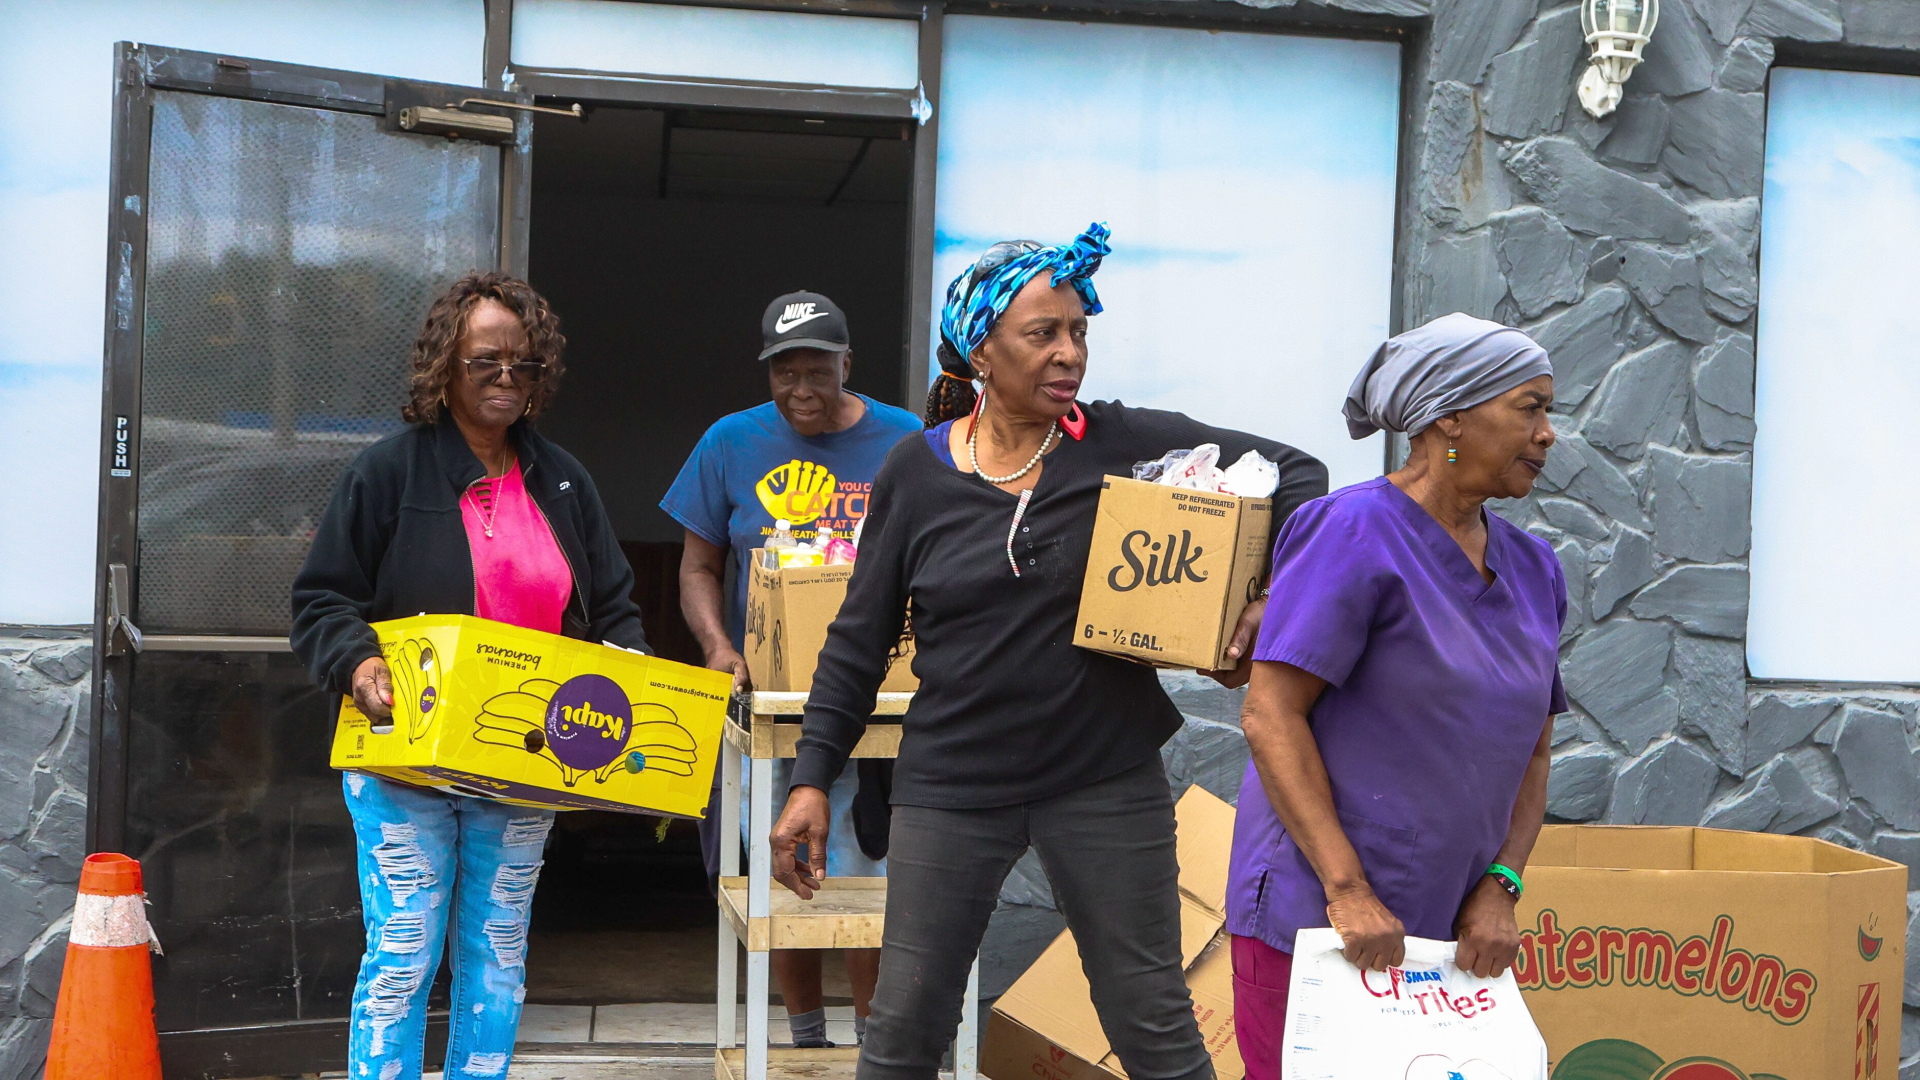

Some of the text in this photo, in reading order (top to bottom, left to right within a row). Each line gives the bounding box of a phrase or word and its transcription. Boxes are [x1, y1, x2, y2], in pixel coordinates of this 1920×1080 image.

[782, 301, 818, 321] NIKE
[115, 417, 128, 467] PUSH
[838, 481, 862, 492] YOU
[1171, 492, 1235, 509] KEEP REFRIGERATED
[1178, 503, 1226, 518] DO NOT FREEZE
[814, 519, 832, 529] ME
[833, 519, 848, 529] AT
[1107, 529, 1208, 593] Silk
[1084, 623, 1094, 639] 6
[1130, 632, 1164, 652] GAL.
[477, 643, 542, 671] bananas
[487, 657, 527, 670] PREMIUM
[650, 681, 725, 702] www.kapigrowers.com
[560, 701, 624, 741] Kapi
[1514, 908, 1817, 1026] atermelons
